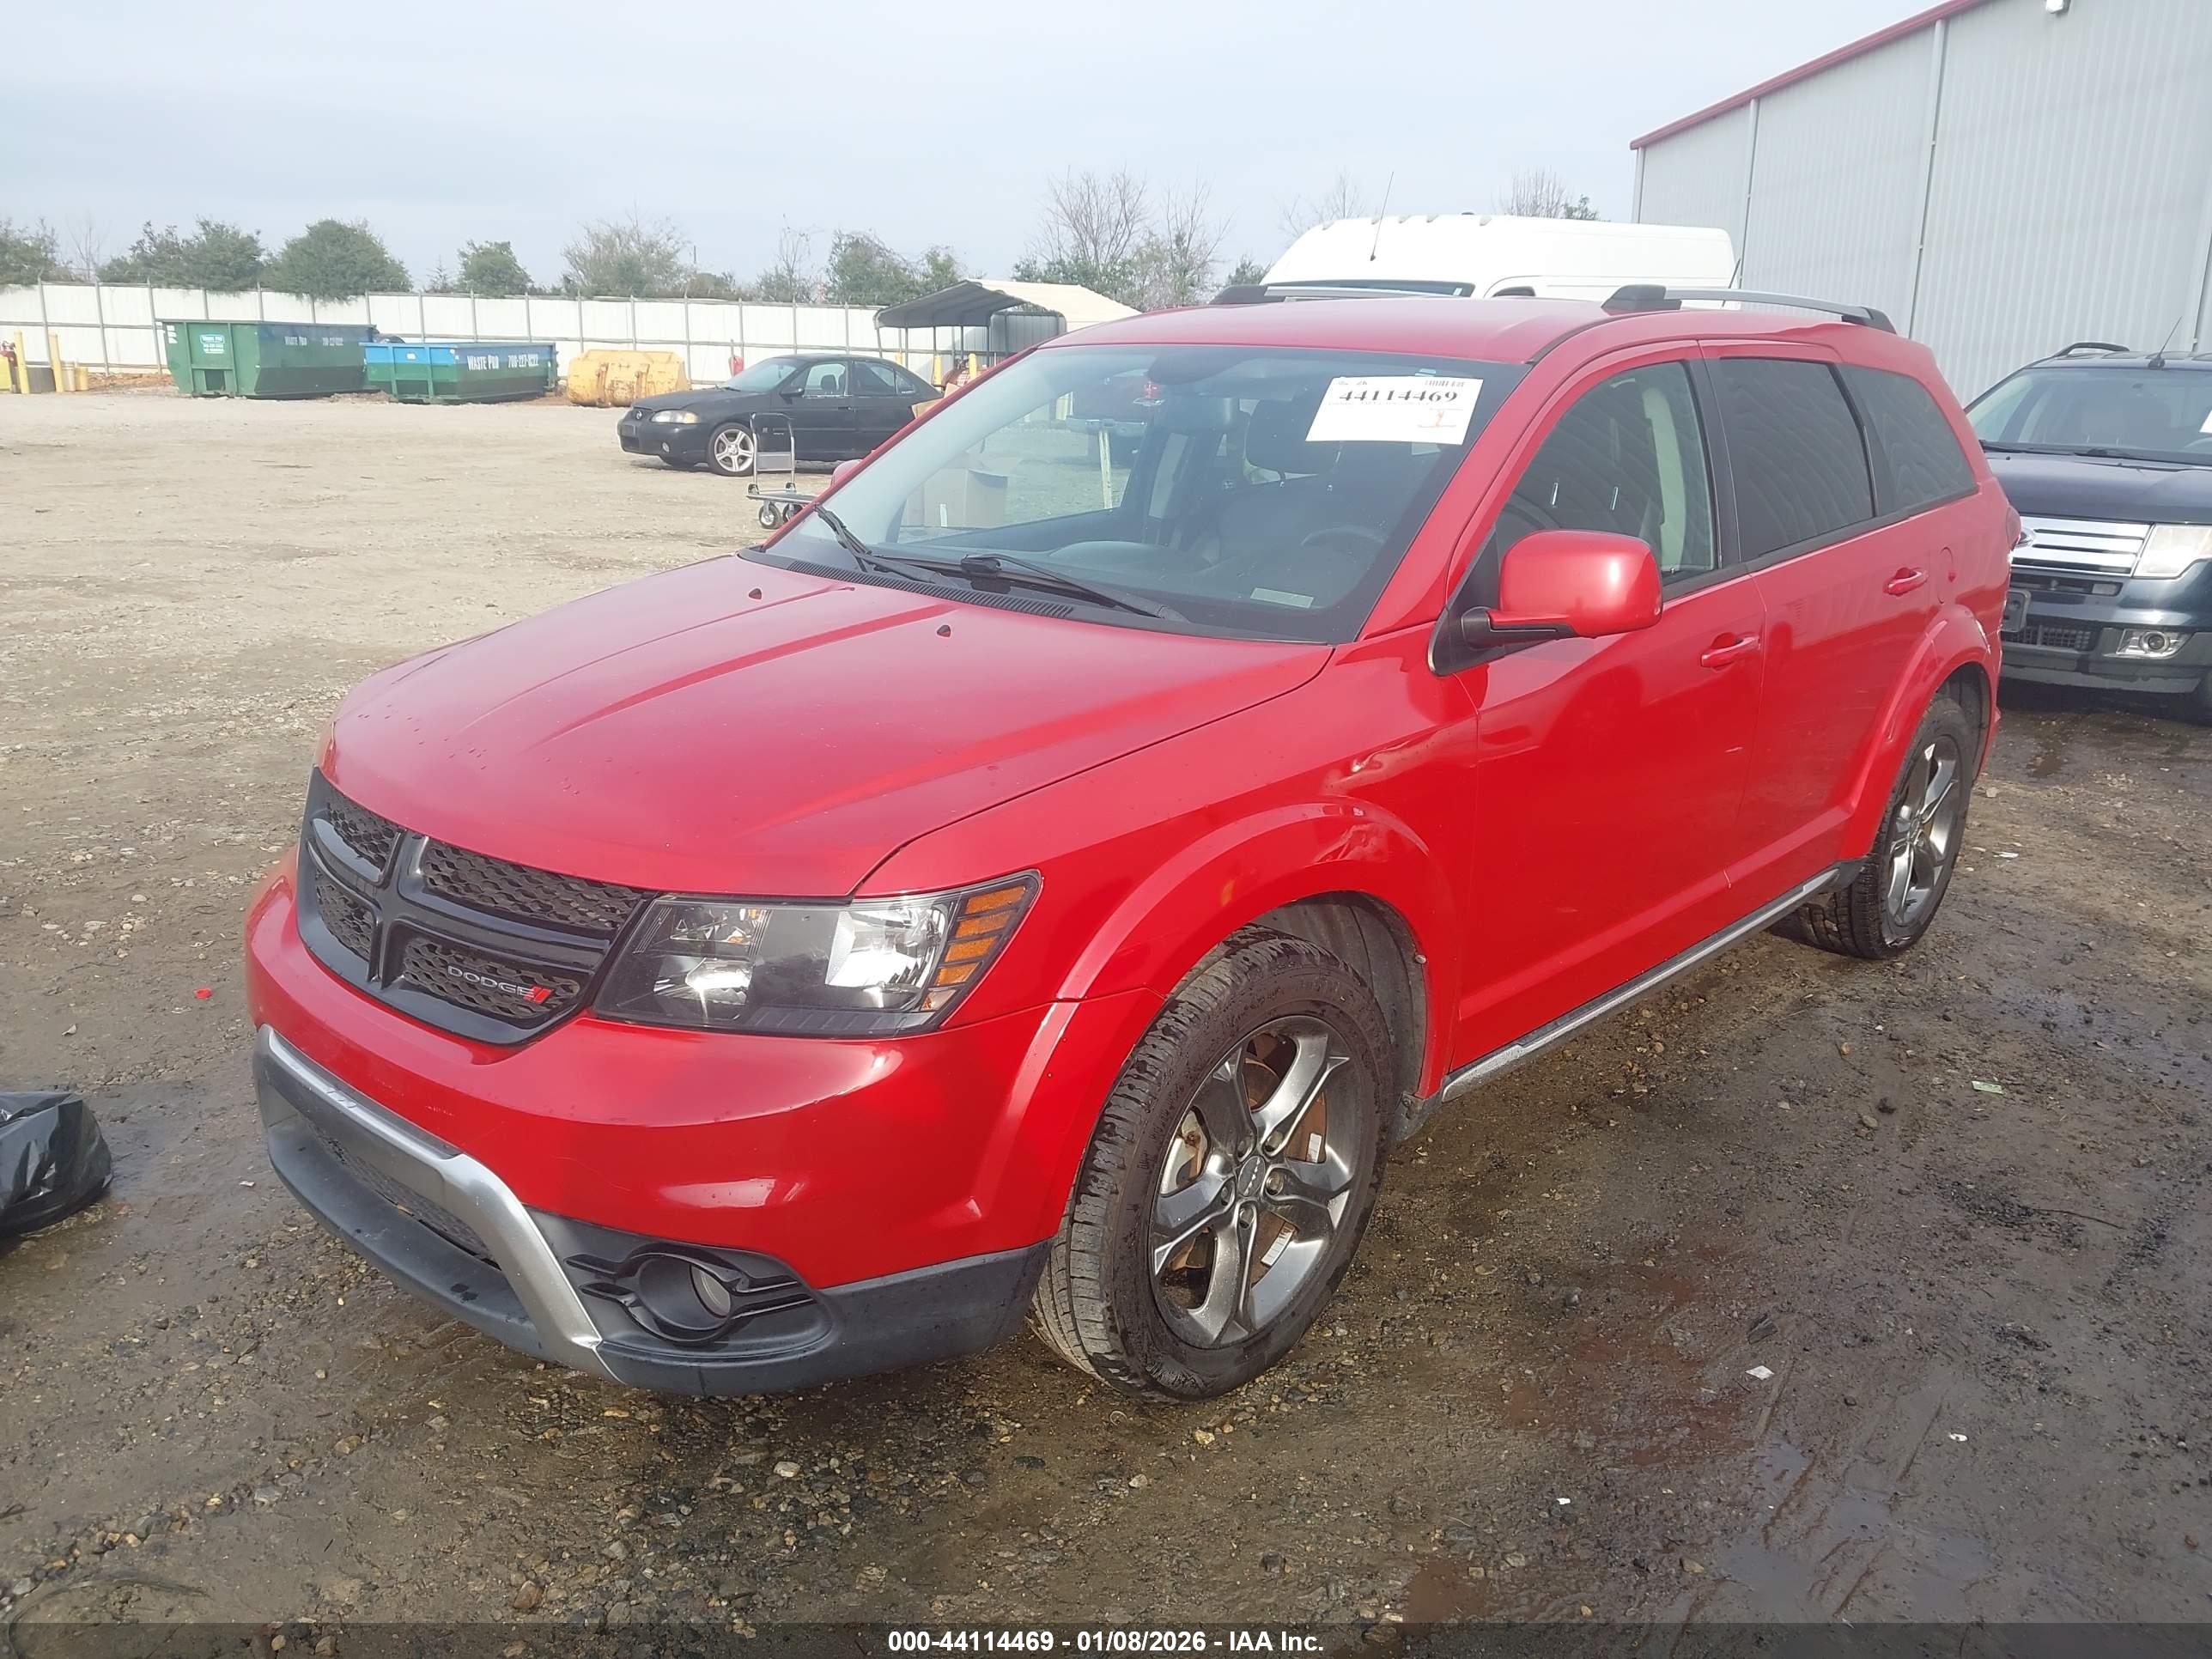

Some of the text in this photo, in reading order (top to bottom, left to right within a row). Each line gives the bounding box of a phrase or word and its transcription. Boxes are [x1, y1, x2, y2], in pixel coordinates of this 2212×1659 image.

[467, 355, 487, 371] WASTE
[487, 354, 500, 370] PRO
[1339, 389, 1458, 403] 44114469
[447, 965, 535, 998] DODGE
